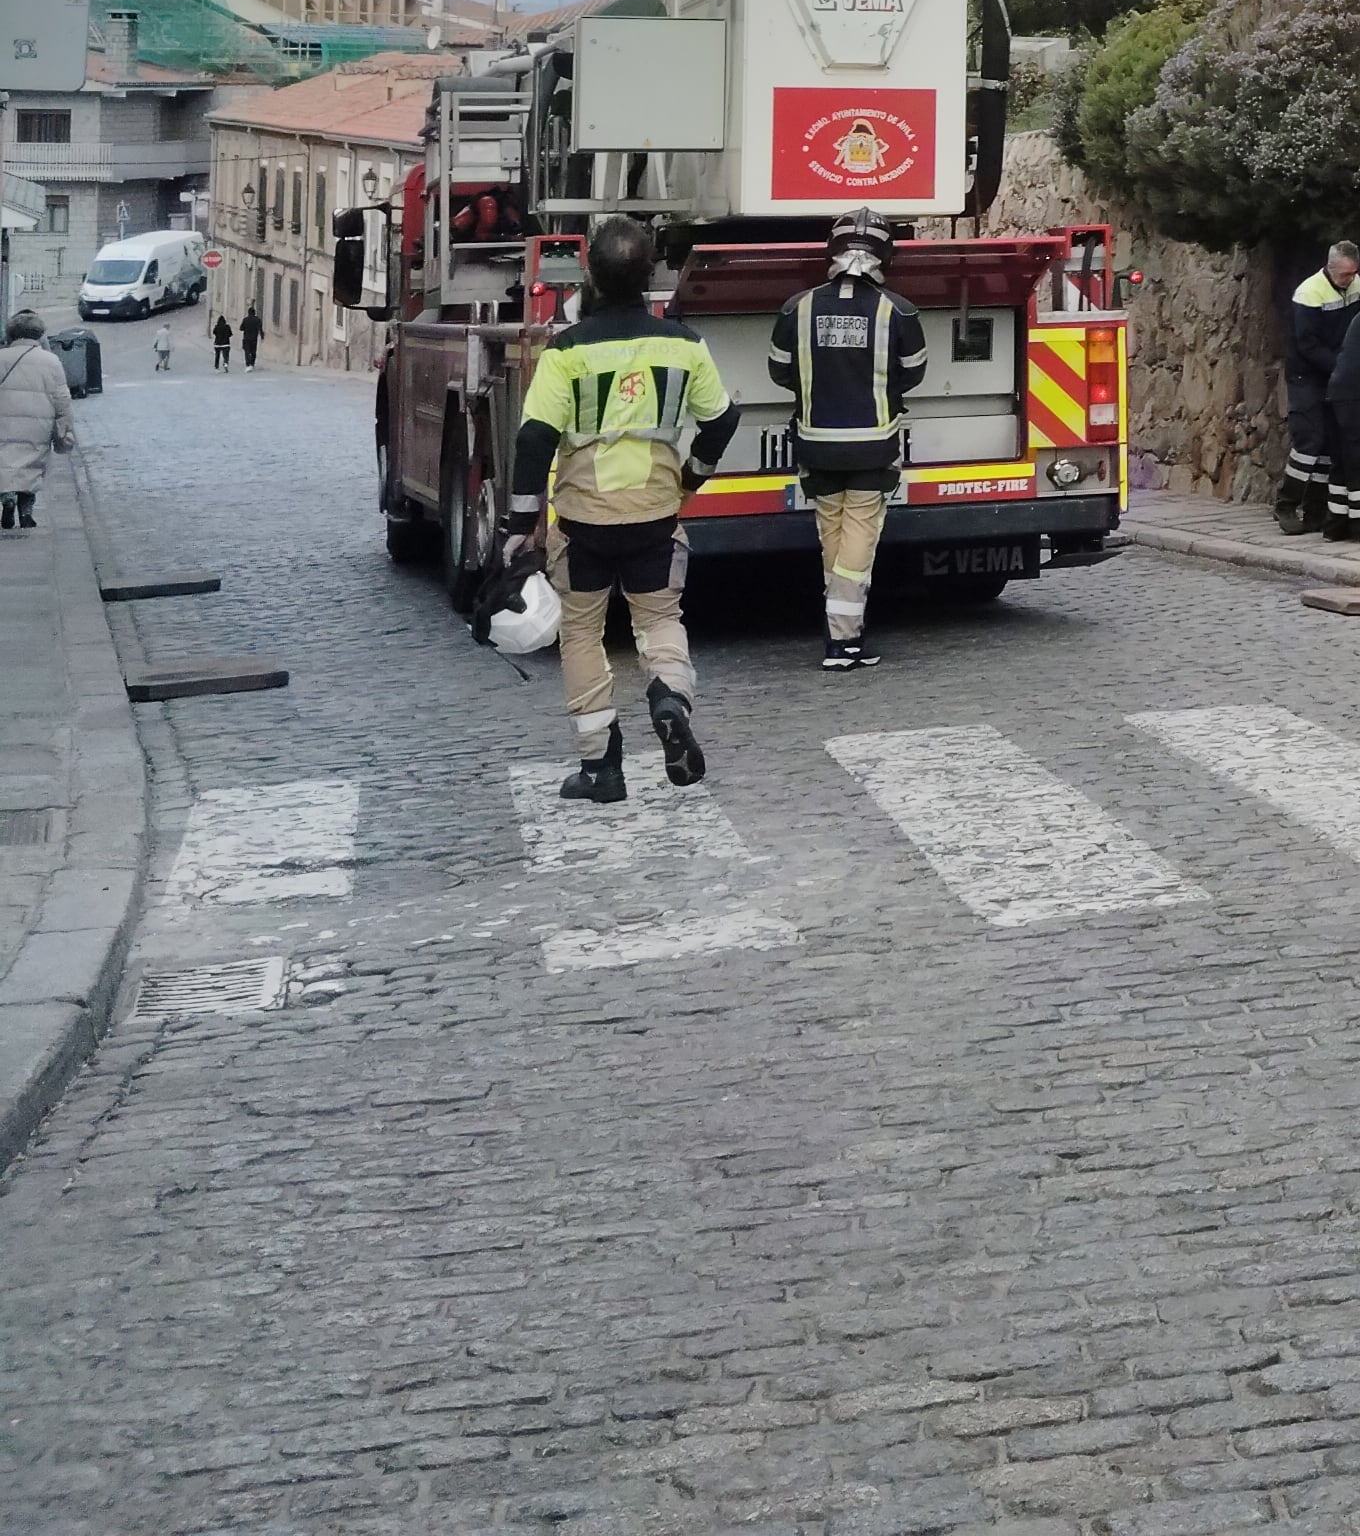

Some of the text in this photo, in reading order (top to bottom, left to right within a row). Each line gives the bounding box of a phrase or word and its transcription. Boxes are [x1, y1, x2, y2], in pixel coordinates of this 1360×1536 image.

[831, 108, 887, 121] AYUNTAMIENTO
[887, 114, 899, 124] DE
[808, 157, 915, 187] SERVICIO CONTRA INCENDIOS
[817, 317, 867, 330] BOMBEROS
[937, 478, 1029, 496] PROTEC-FIRE
[954, 546, 1024, 574] VEMA
